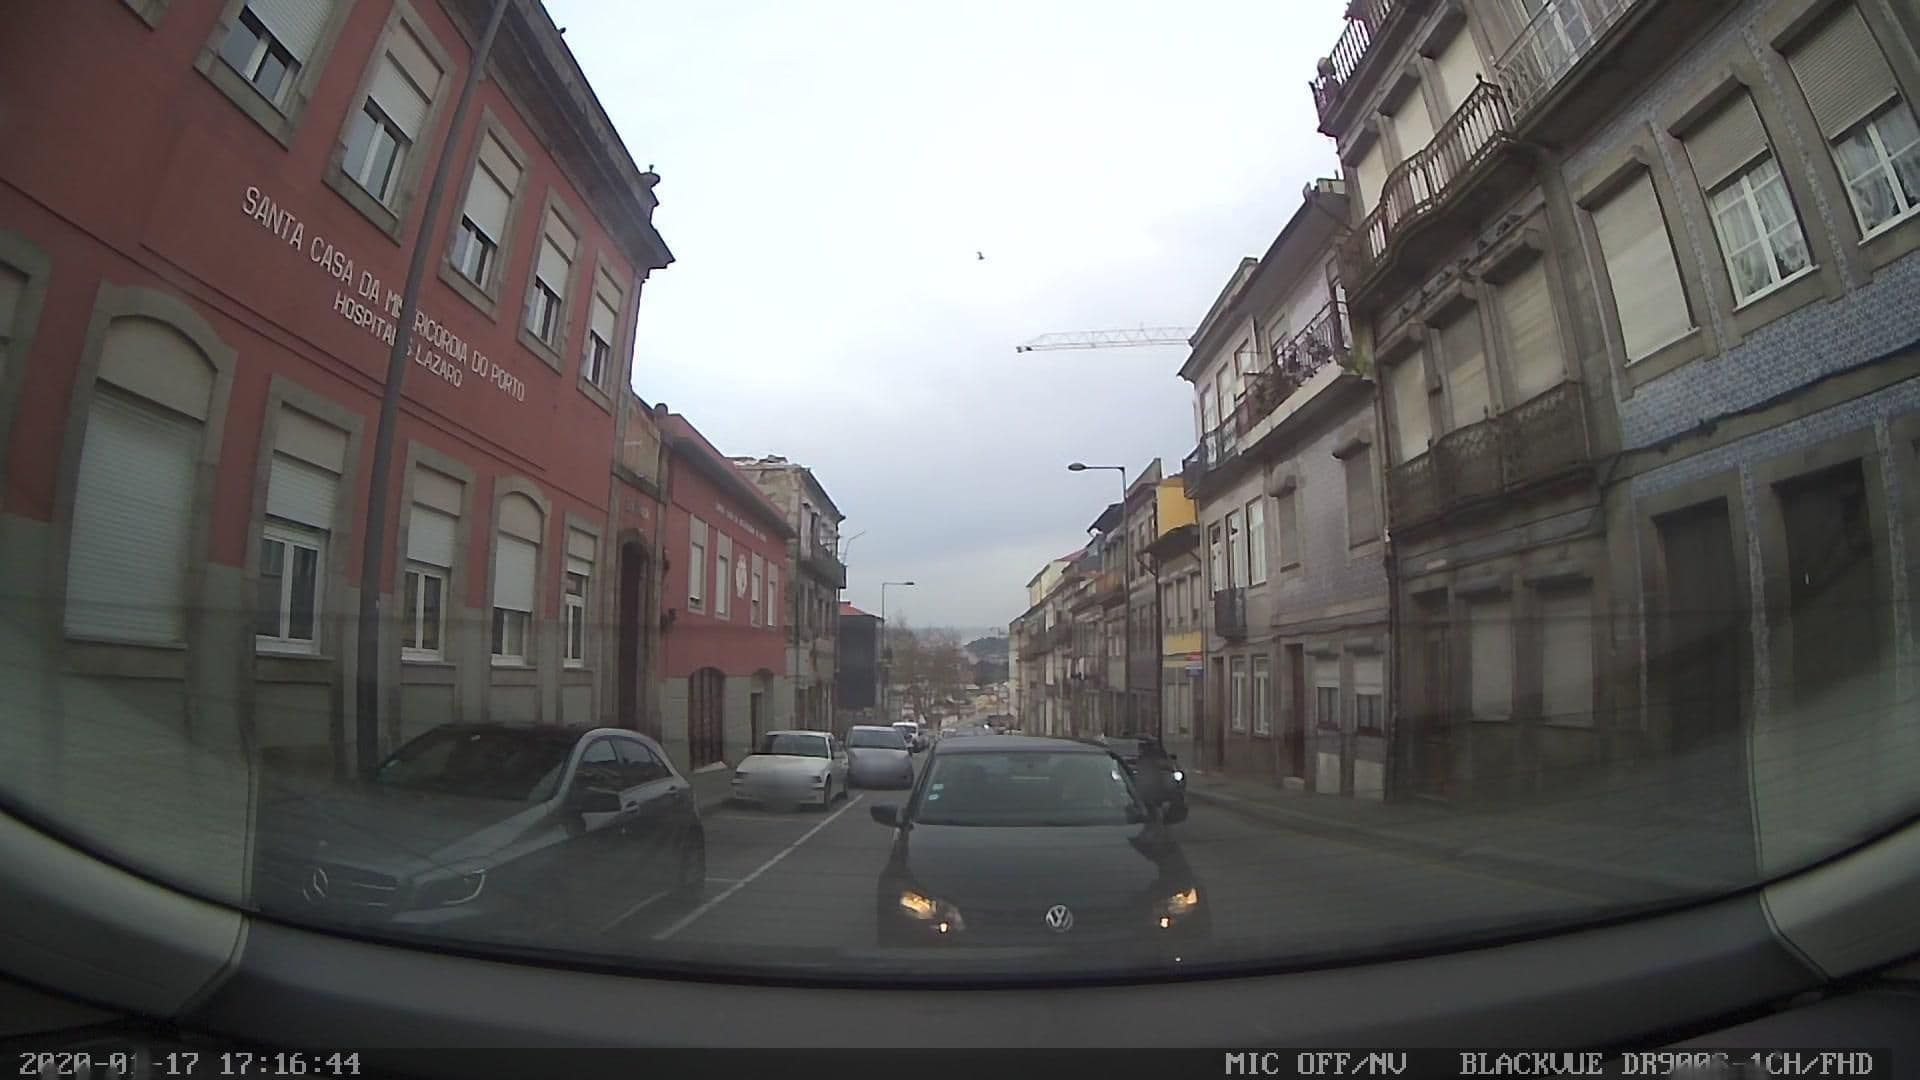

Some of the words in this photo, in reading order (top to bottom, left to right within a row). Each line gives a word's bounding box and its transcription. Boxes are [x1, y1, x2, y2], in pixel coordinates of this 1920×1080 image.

[242, 186, 304, 250] SANTA
[310, 236, 353, 288] CASA
[358, 269, 380, 304] DA
[472, 350, 489, 377] DO
[490, 364, 525, 402] PORTO
